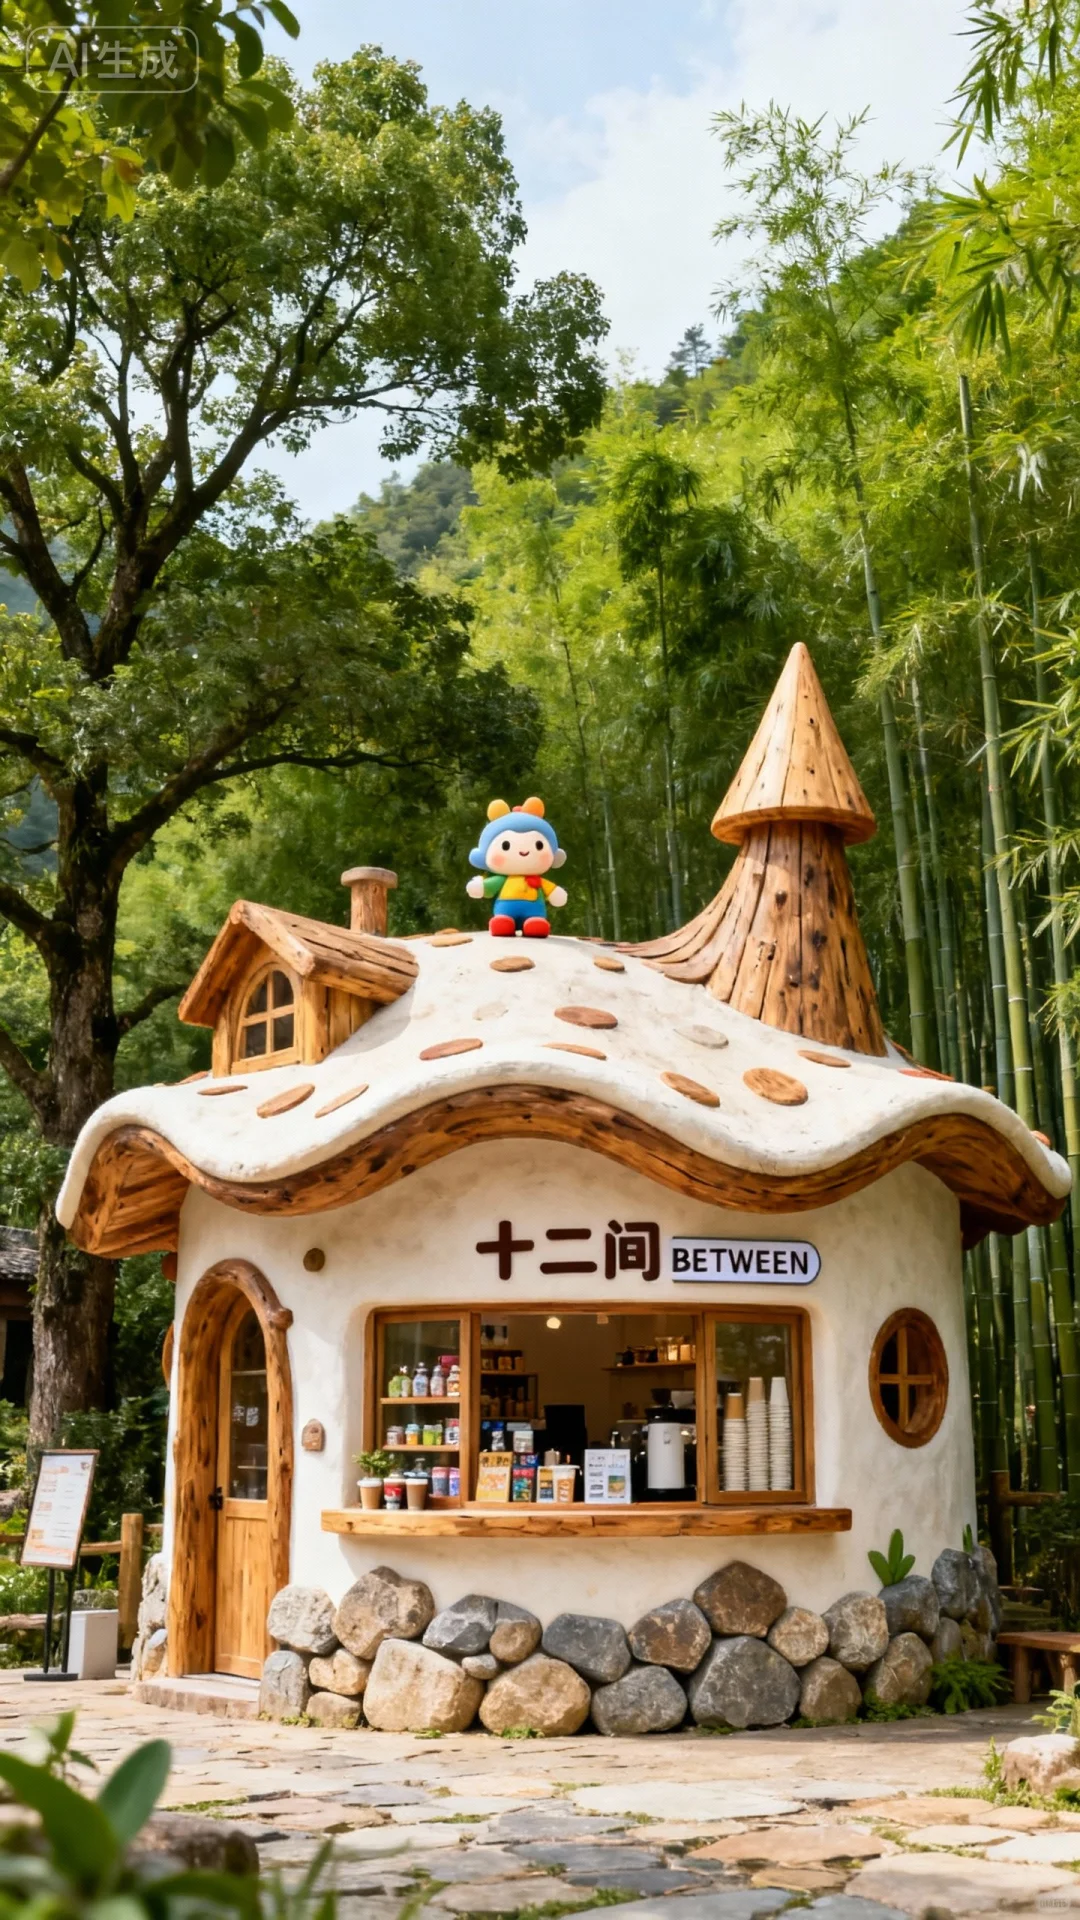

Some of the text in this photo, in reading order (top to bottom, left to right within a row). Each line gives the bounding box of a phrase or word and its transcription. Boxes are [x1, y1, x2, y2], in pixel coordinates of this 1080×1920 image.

[475, 1219, 661, 1282] 十二间
[672, 1247, 809, 1275] BETWEEN
